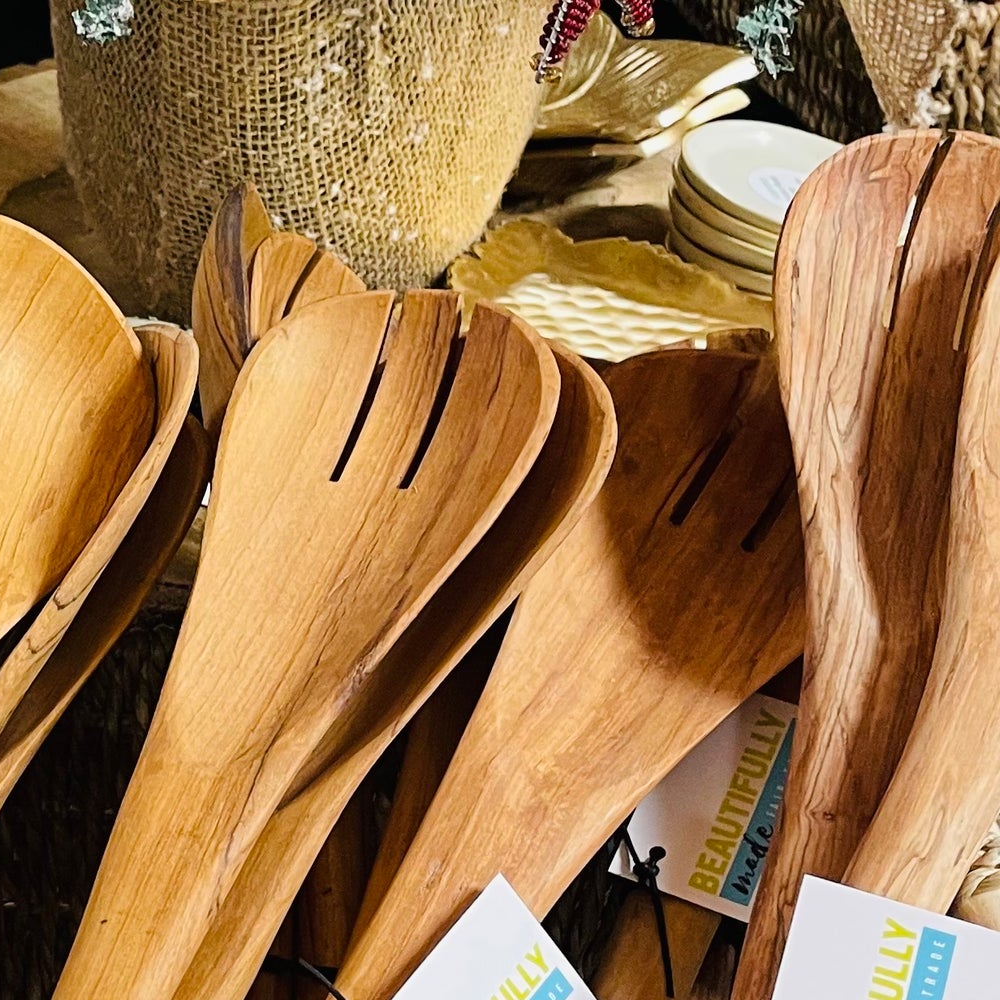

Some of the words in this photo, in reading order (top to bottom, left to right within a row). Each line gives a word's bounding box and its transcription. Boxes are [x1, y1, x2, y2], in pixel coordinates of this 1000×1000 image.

[688, 707, 786, 895] BEAUTIFULLY
[731, 823, 774, 896] made
[921, 939, 947, 998] TRADE
